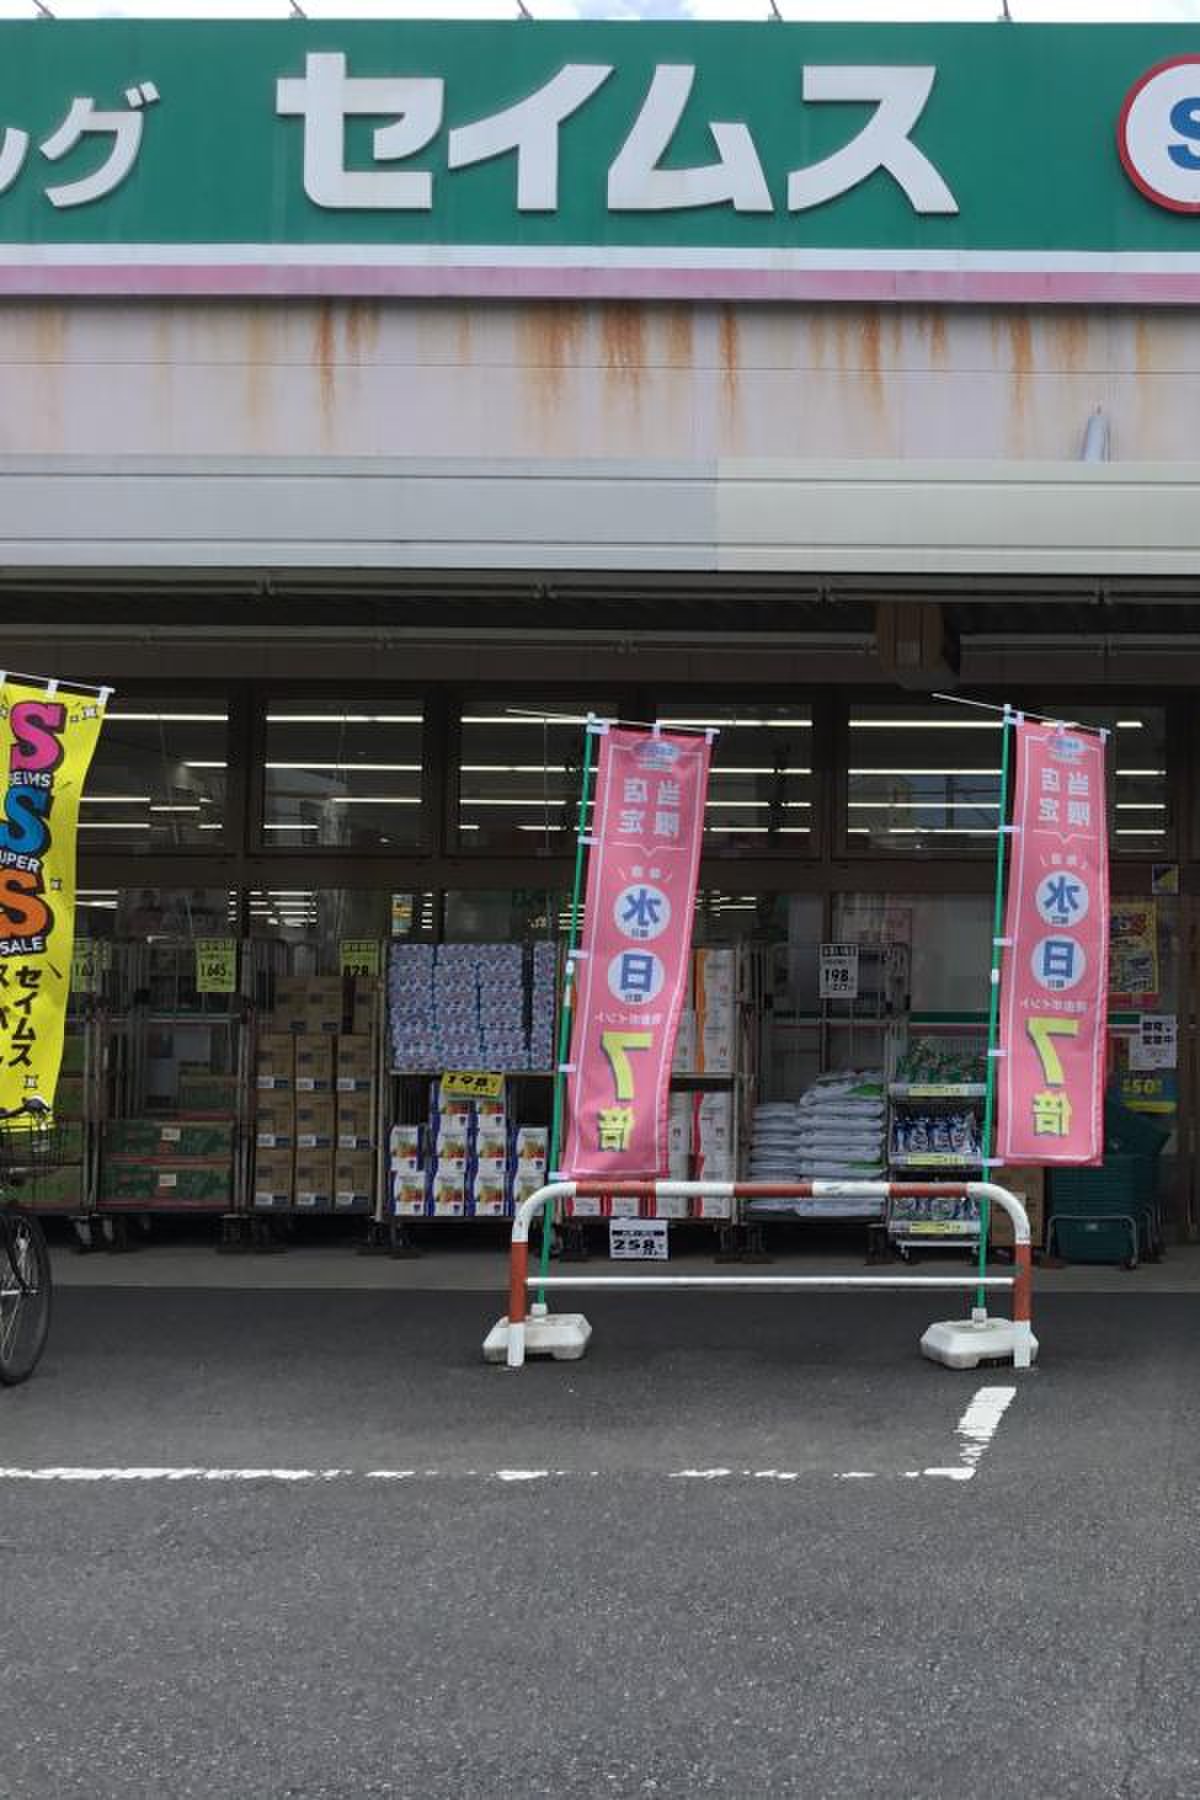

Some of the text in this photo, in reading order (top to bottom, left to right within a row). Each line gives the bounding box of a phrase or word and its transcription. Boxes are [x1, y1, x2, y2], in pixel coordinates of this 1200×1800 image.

[276, 51, 960, 214] セイムス
[10, 702, 66, 771] S
[0, 785, 47, 853] S
[0, 869, 49, 938] S
[0, 937, 43, 956] SALE
[8, 966, 42, 1067] セイムス
